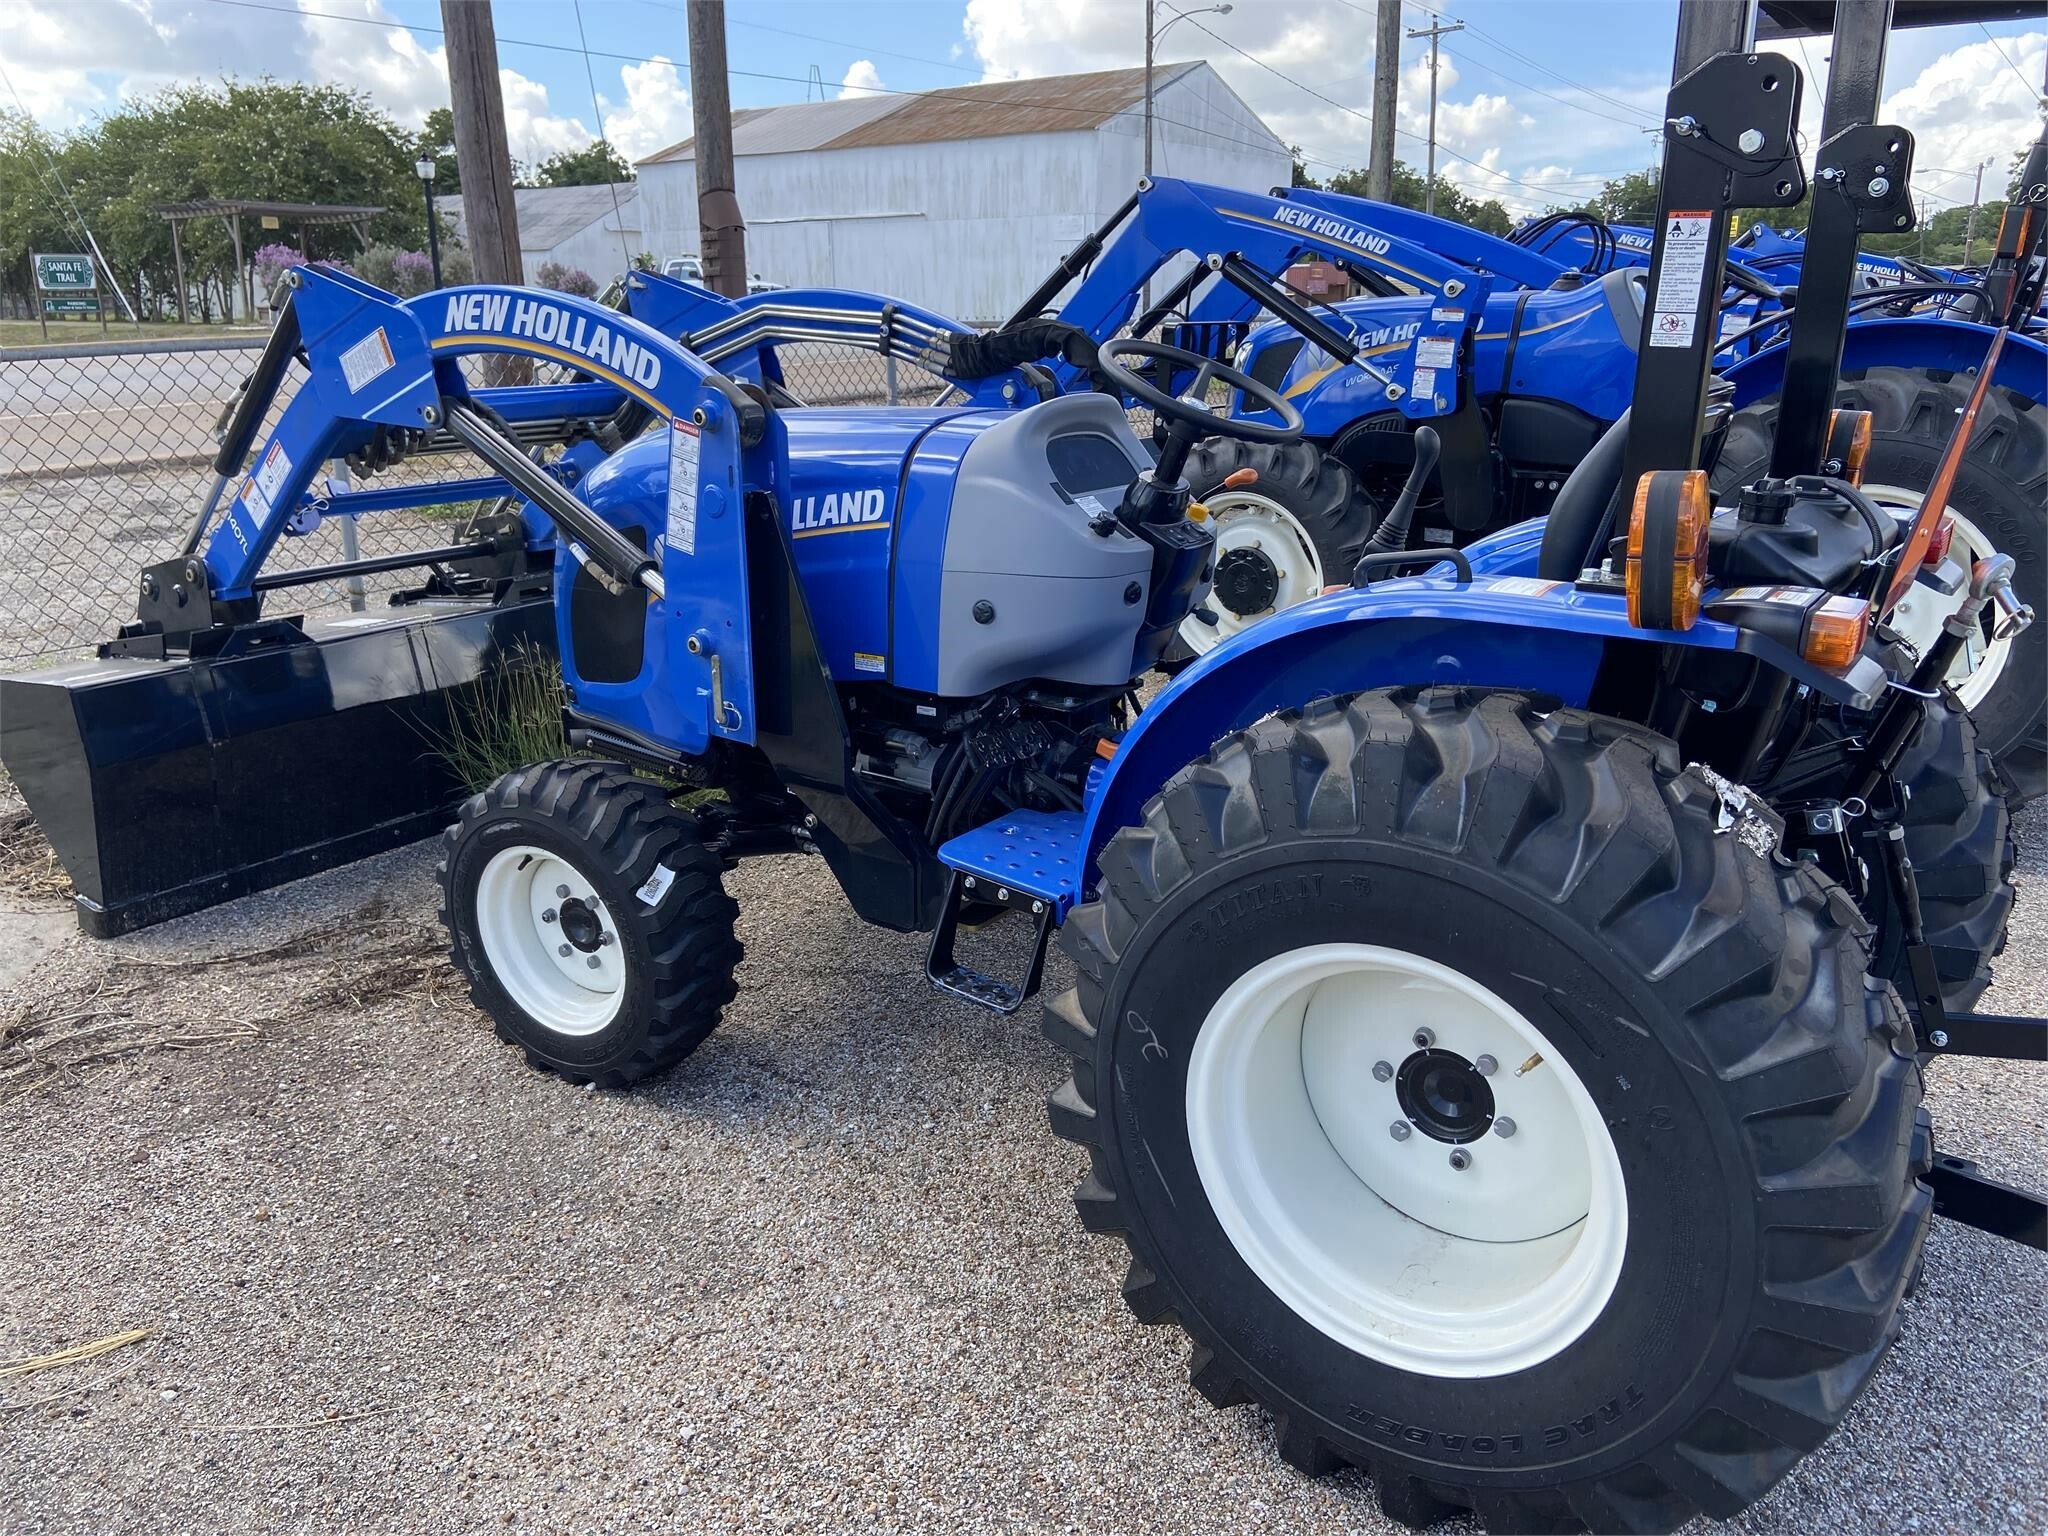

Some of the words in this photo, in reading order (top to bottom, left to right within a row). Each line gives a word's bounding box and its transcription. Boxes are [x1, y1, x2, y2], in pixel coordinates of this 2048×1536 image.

[1272, 205, 1315, 230] NEW
[1311, 216, 1391, 255] HOLLAND
[1617, 232, 1650, 249] NEW
[47, 261, 73, 272] SANTA
[73, 262, 82, 272] FE
[56, 272, 77, 283] TRAIL
[444, 294, 511, 333] NEW
[511, 298, 662, 391] HOLLAND
[1208, 873, 1325, 928] TITAN
[1345, 1404, 1523, 1454] LOADER
